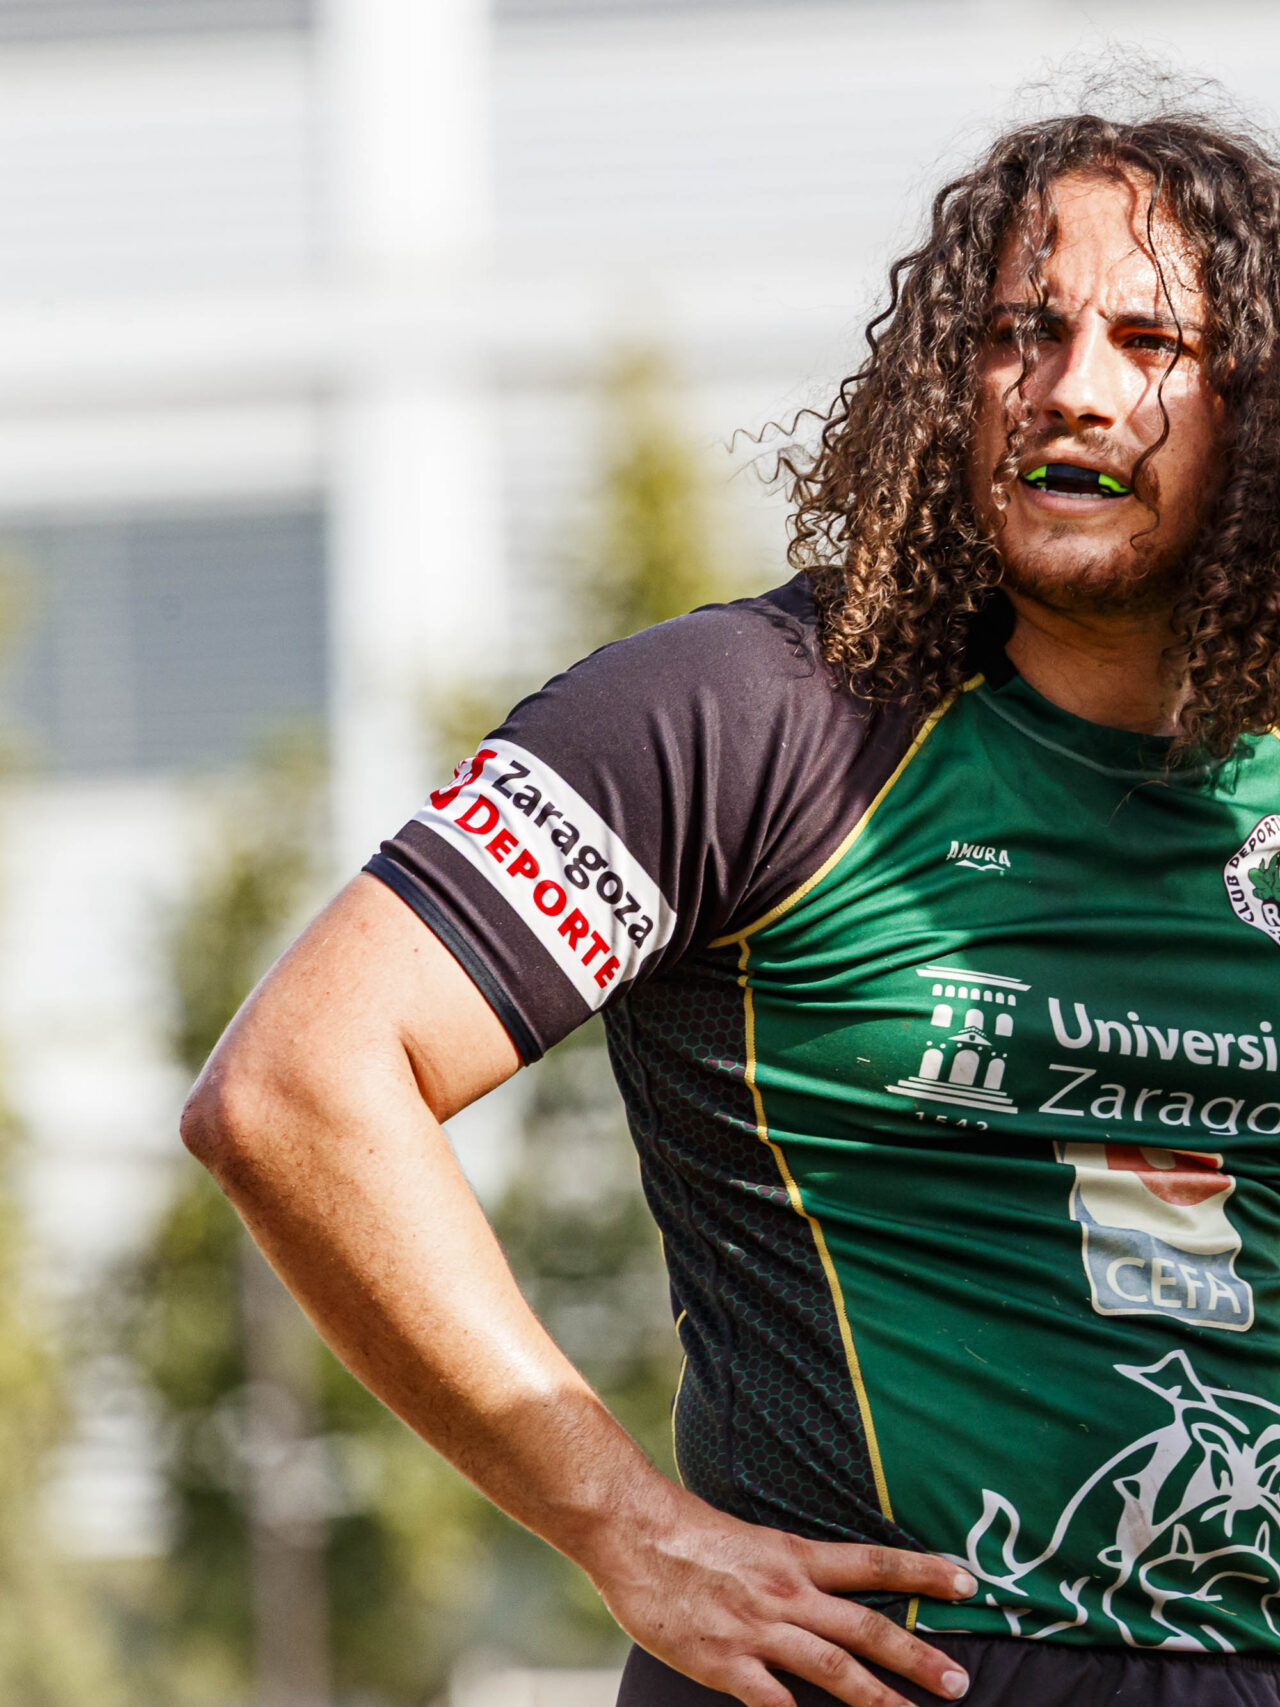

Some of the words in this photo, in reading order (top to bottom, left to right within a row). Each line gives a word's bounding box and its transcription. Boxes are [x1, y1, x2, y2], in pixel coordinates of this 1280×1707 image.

[491, 759, 654, 949] Zaragoza
[945, 840, 1011, 868] AMURA
[453, 793, 621, 989] DEPORTE
[1226, 874, 1255, 922] CLUB
[1105, 1256, 1243, 1315] CEFA
